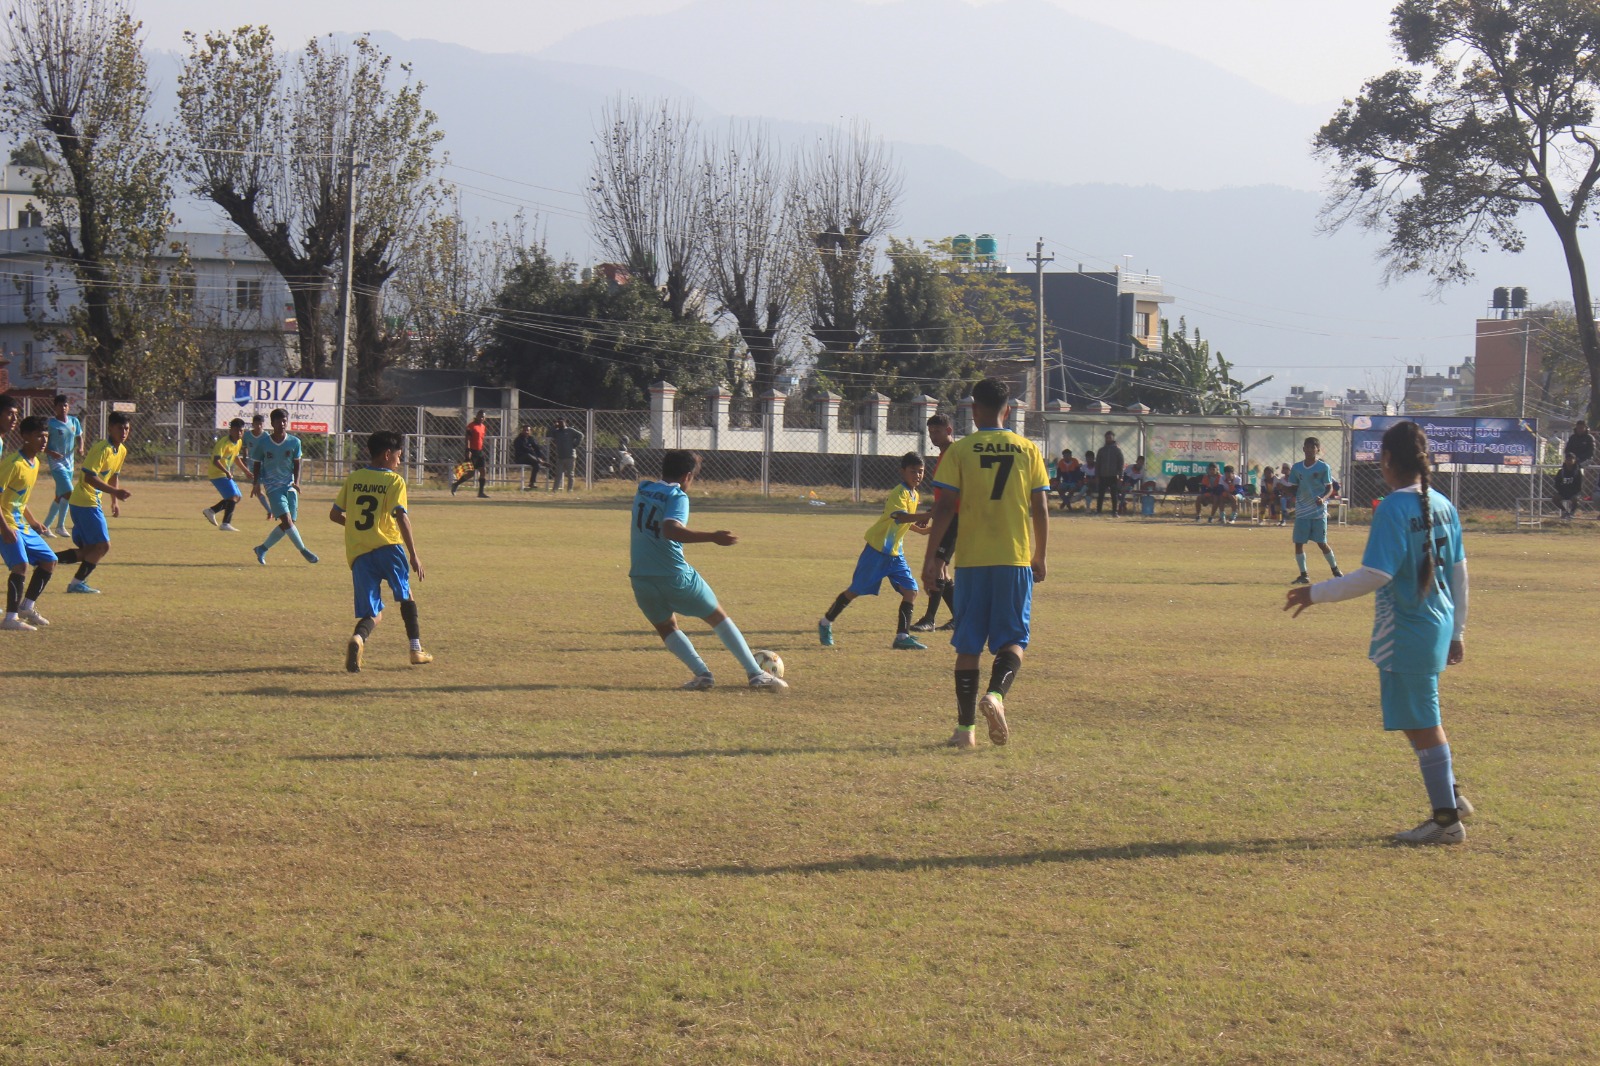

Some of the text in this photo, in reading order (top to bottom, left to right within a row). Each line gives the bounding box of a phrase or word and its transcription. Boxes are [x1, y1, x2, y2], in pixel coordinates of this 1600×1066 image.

[256, 379, 314, 402] BIZZ
[255, 402, 315, 410] DUCATION
[973, 443, 1022, 453] SALIN
[1165, 461, 1191, 474] Player
[1192, 463, 1207, 473] Box
[979, 454, 1015, 501] 7
[352, 483, 387, 494] PRAJWOL
[354, 494, 379, 531] 3
[637, 502, 661, 539] 14
